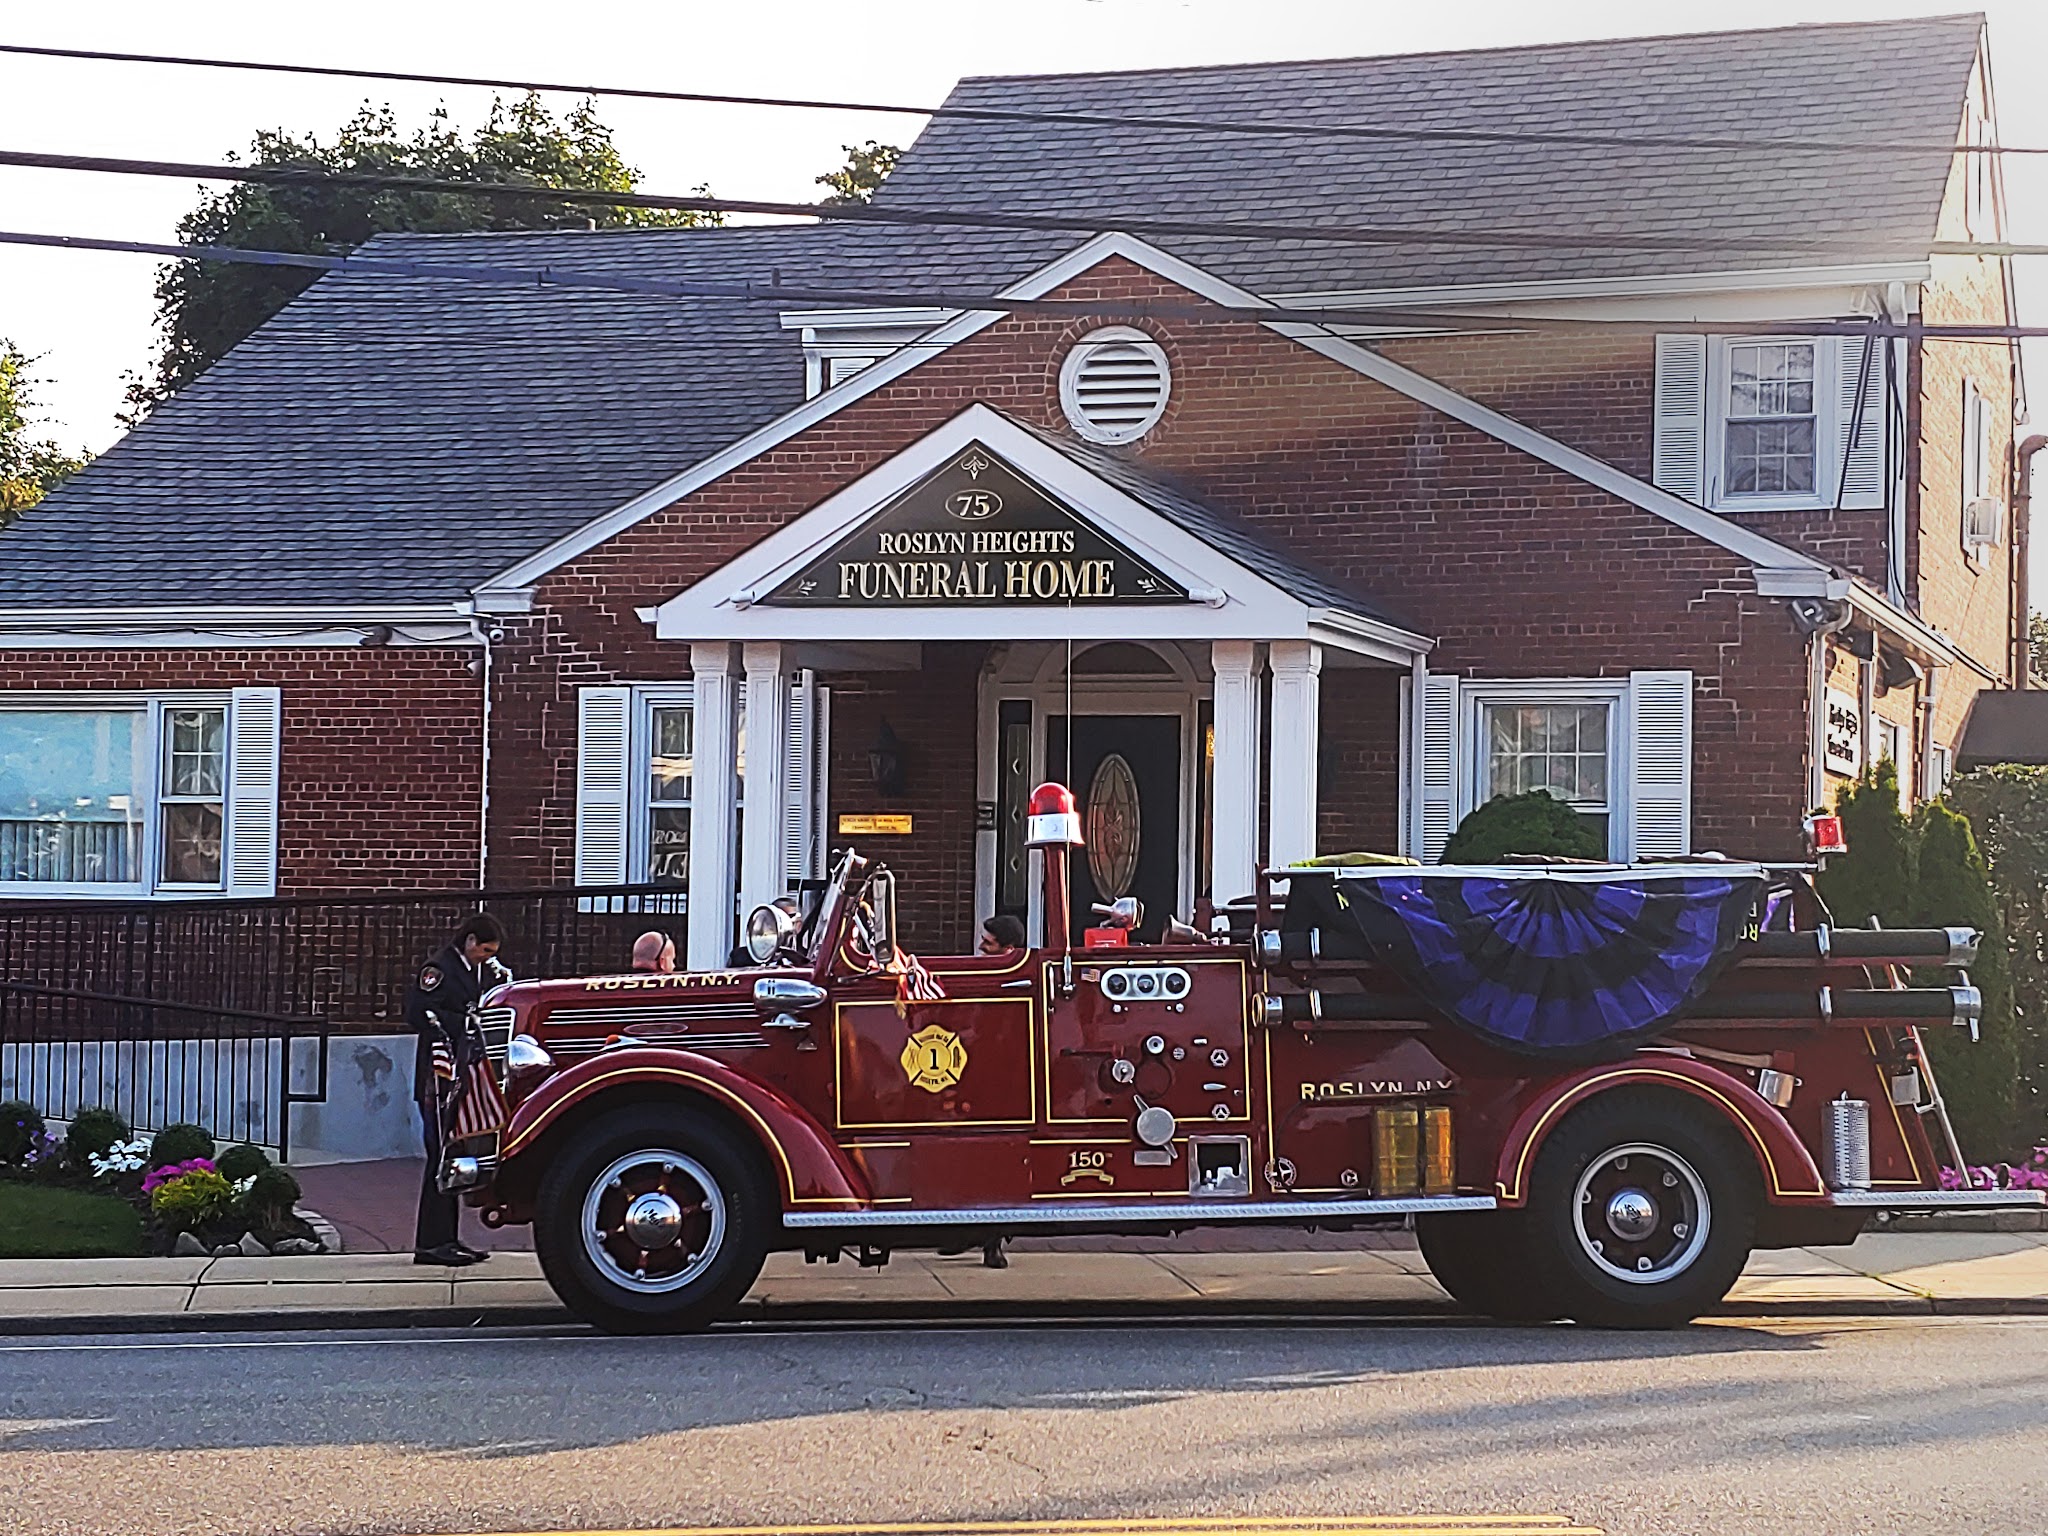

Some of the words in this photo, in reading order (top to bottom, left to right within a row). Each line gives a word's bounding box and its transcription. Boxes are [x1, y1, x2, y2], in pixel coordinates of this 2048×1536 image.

[956, 495, 991, 518] 75
[878, 531, 966, 555] ROSLYN
[971, 530, 1076, 554] HEIGHTS
[837, 559, 997, 600] FUNERAL
[1003, 559, 1116, 599] HOME
[929, 1048, 940, 1070] 1
